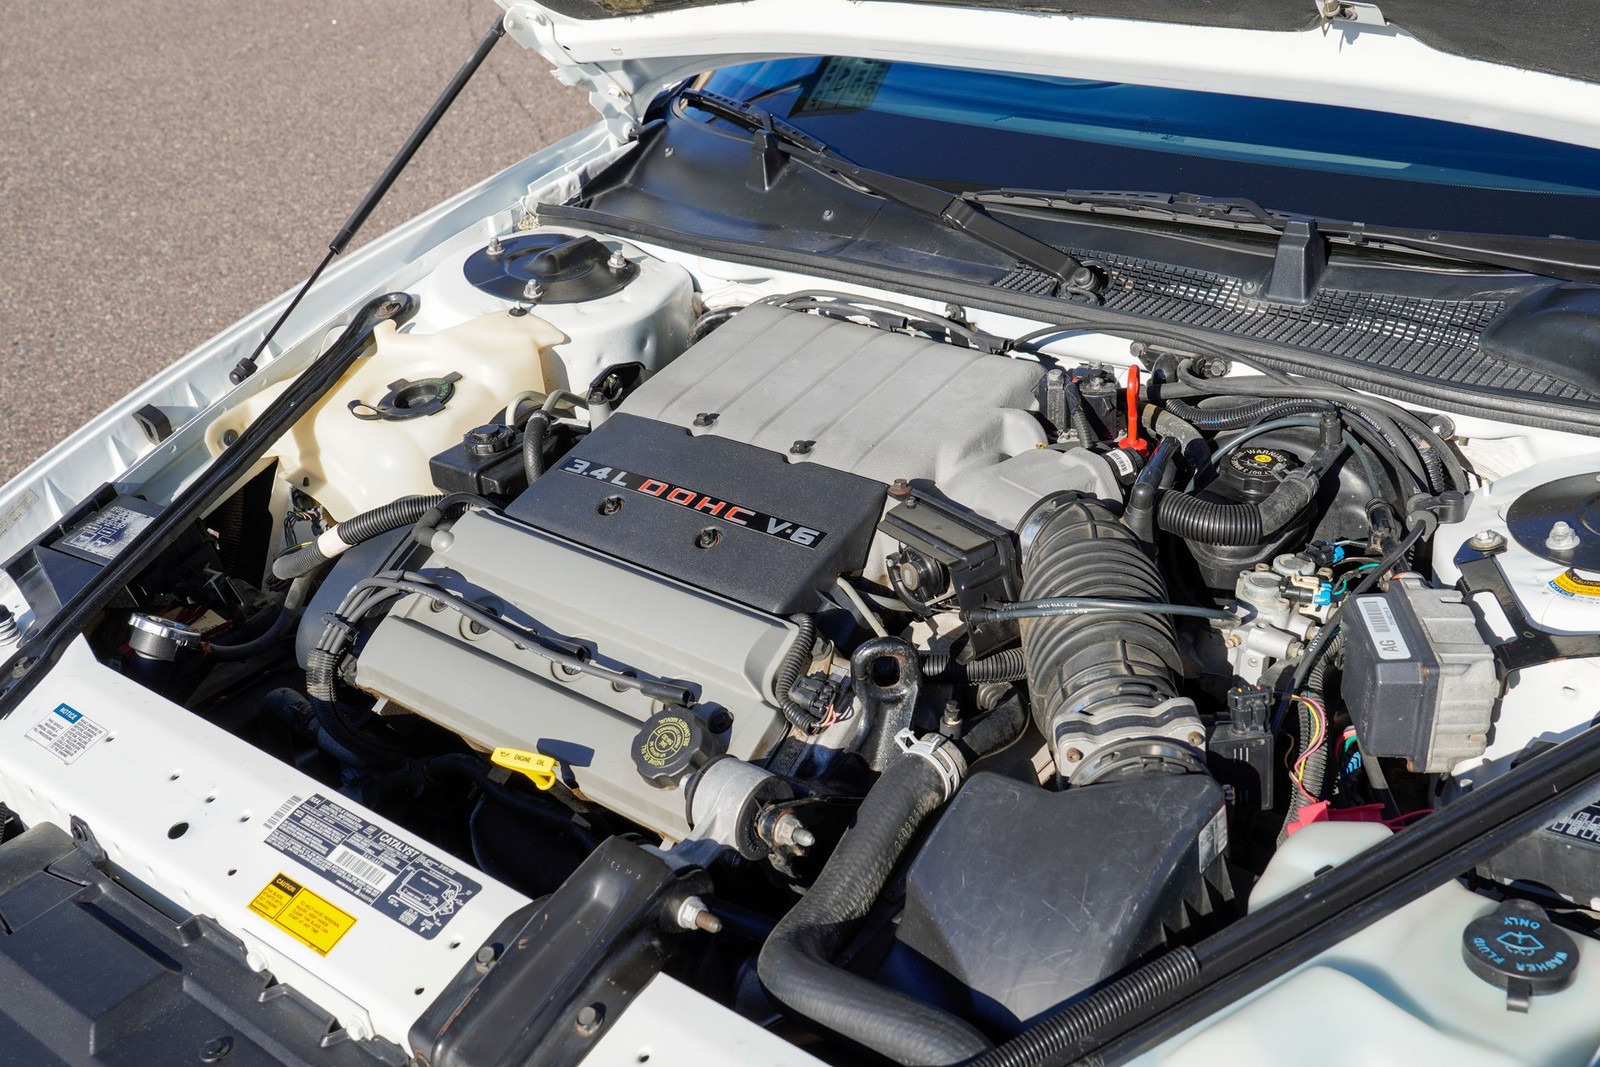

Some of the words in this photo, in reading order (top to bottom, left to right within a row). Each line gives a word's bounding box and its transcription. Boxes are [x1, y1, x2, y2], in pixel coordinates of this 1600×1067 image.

[637, 479, 757, 526] DOHC
[1380, 639, 1399, 652] AG
[58, 706, 78, 720] NOTICE
[514, 753, 531, 764] ENGINE
[536, 759, 545, 767] OIL
[380, 833, 420, 858] CATALYST
[276, 878, 297, 893] CAUTION
[1504, 917, 1541, 930] ONLY
[1473, 937, 1505, 964] FLUID
[1515, 951, 1568, 972] WASHER
